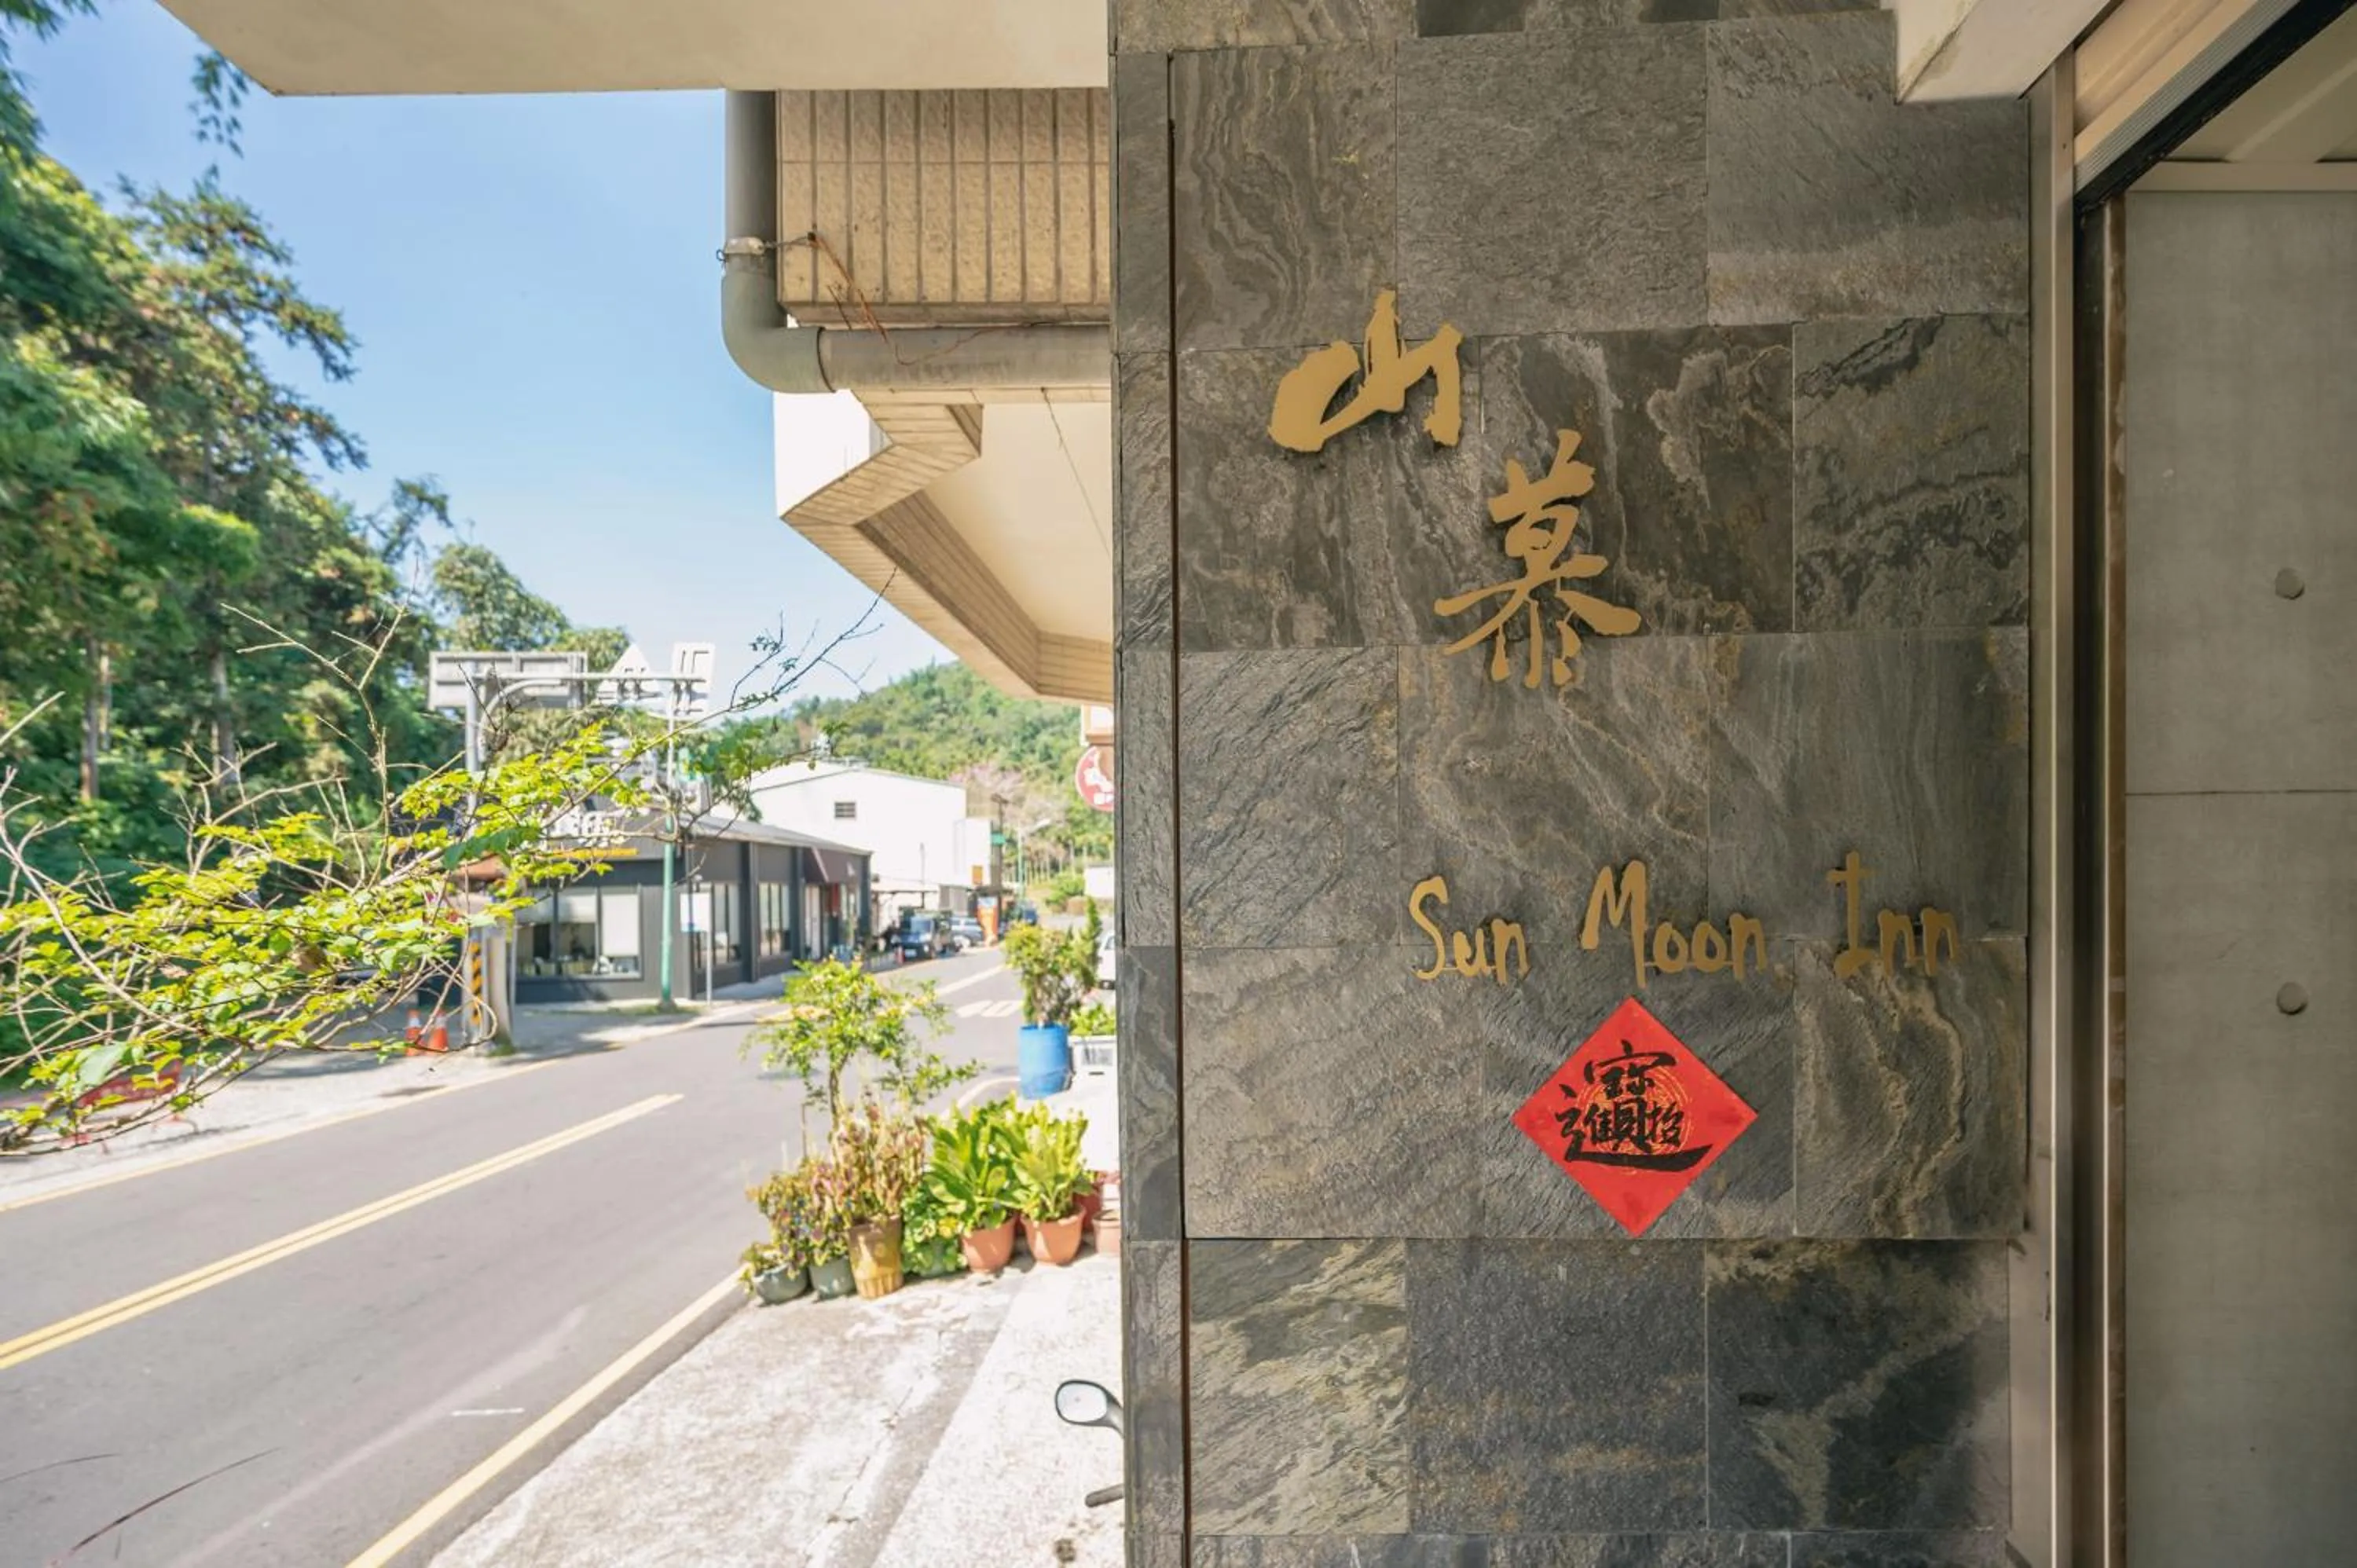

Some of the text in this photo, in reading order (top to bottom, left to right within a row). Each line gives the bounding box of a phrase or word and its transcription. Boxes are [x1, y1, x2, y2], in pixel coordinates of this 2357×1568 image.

[1408, 852, 1959, 988] Sun Moon Inn
